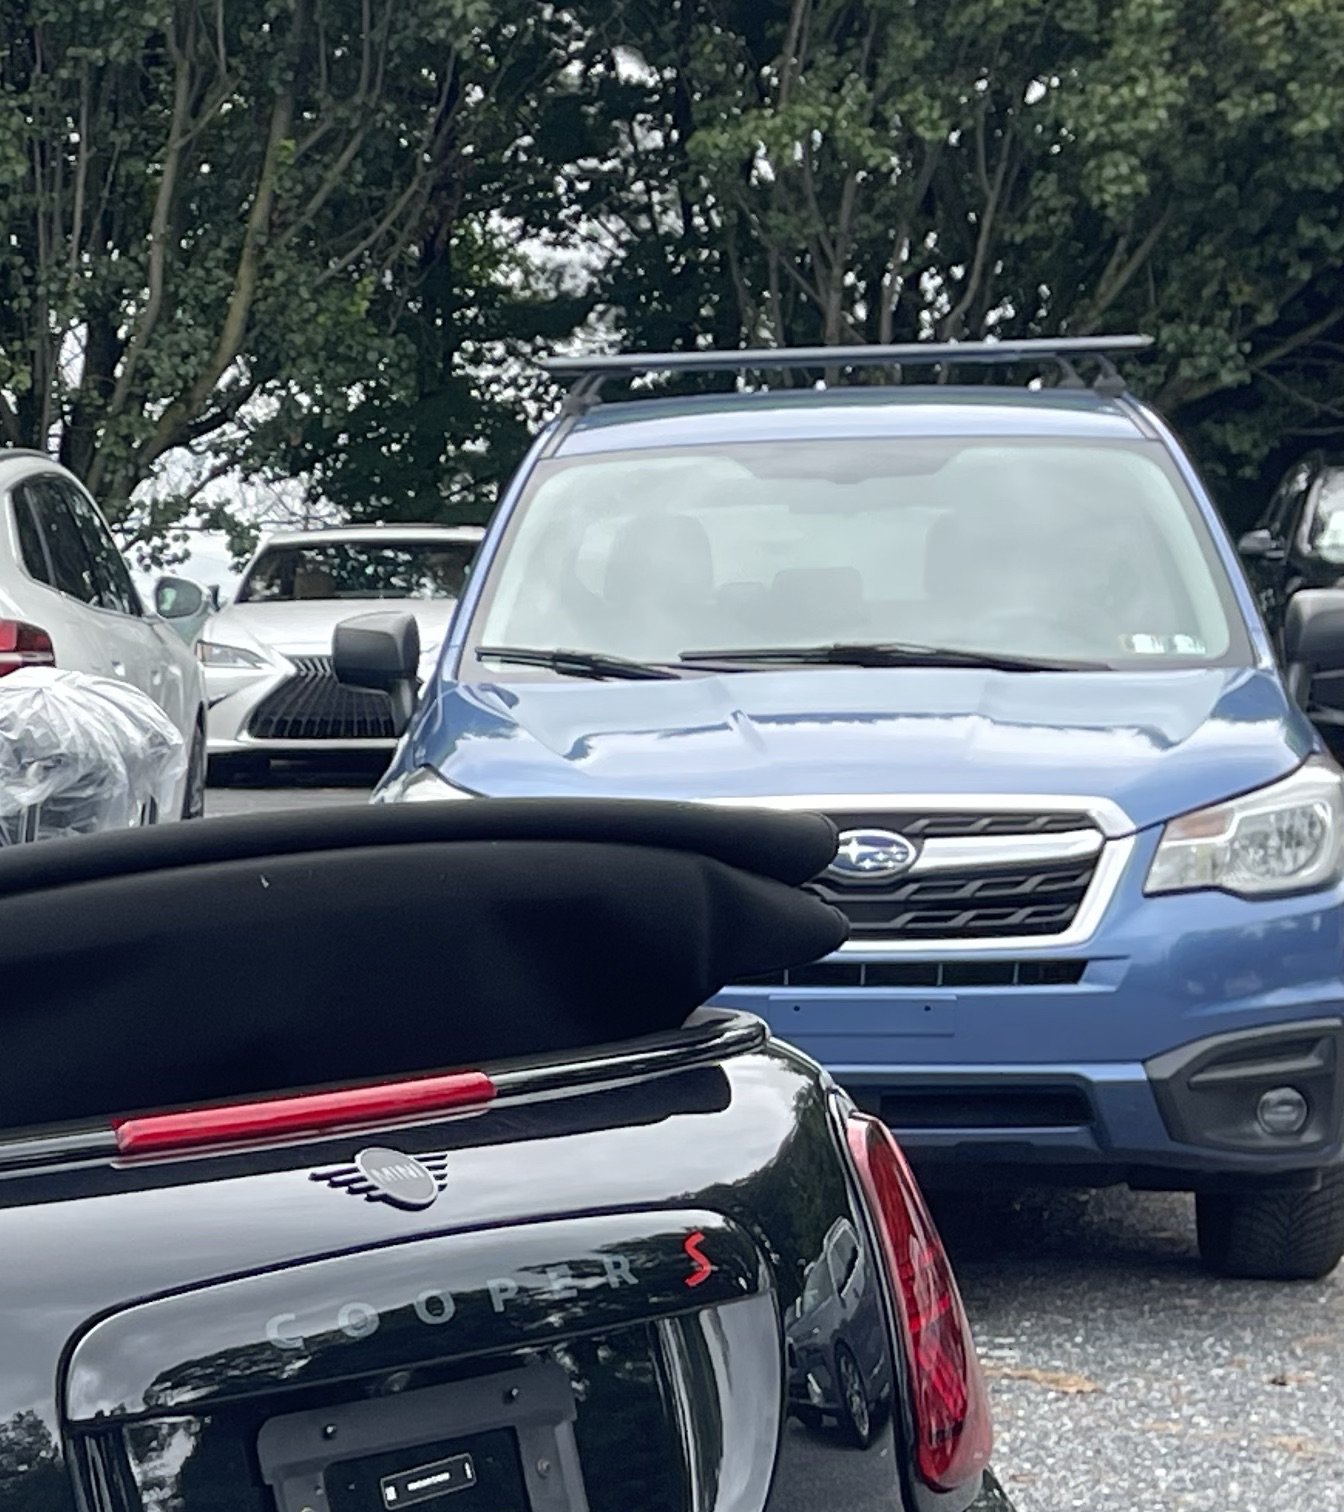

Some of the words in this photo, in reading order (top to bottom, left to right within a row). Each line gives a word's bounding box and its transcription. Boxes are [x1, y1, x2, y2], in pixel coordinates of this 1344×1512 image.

[370, 1162, 425, 1185] MINI
[265, 1253, 639, 1350] COOPER
[684, 1231, 713, 1288] S
